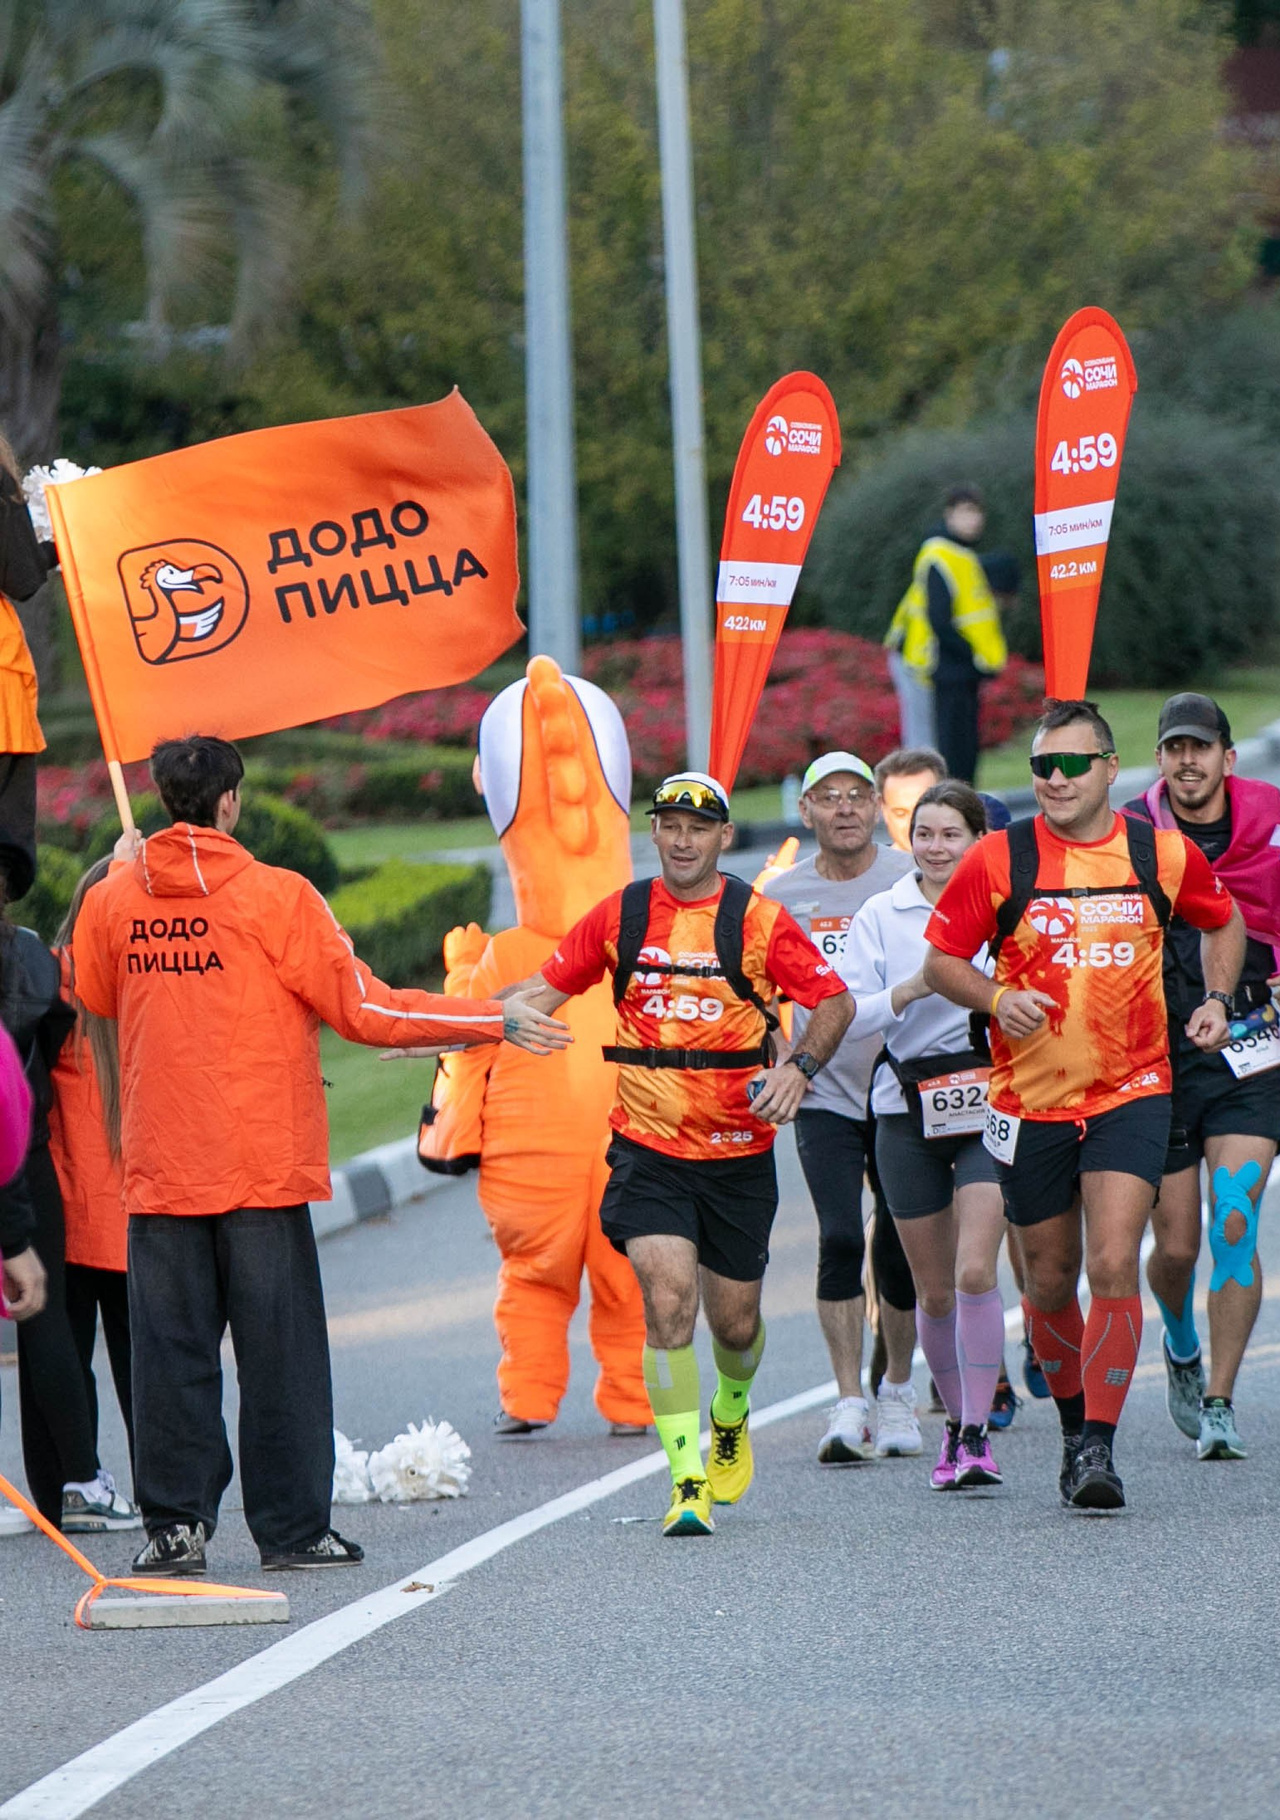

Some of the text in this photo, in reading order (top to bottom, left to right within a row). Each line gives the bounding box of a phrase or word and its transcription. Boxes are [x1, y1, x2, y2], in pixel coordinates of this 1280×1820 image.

[1085, 364, 1116, 382] СОЧИ
[1086, 378, 1117, 390] МАРАФОН
[789, 430, 822, 445] СОЧИ
[788, 444, 821, 454] МАРАФОН
[1051, 432, 1117, 475] 4:59
[742, 494, 805, 531] 4:59
[267, 500, 429, 574] ДОДО
[1049, 523, 1068, 536] 7:05
[1050, 562, 1078, 579] 42.2
[275, 548, 488, 623] ПИЦЦА
[729, 575, 750, 587] 7:05
[1080, 901, 1144, 916] СОЧИ
[1081, 916, 1143, 924] МАРАФОН
[130, 917, 209, 943] ДОДО
[127, 951, 224, 975] ПИЦЦА
[1051, 942, 1135, 968] 4:59
[642, 995, 724, 1021] 4:59
[932, 1086, 988, 1112] 632
[711, 1131, 753, 1143] 2025
